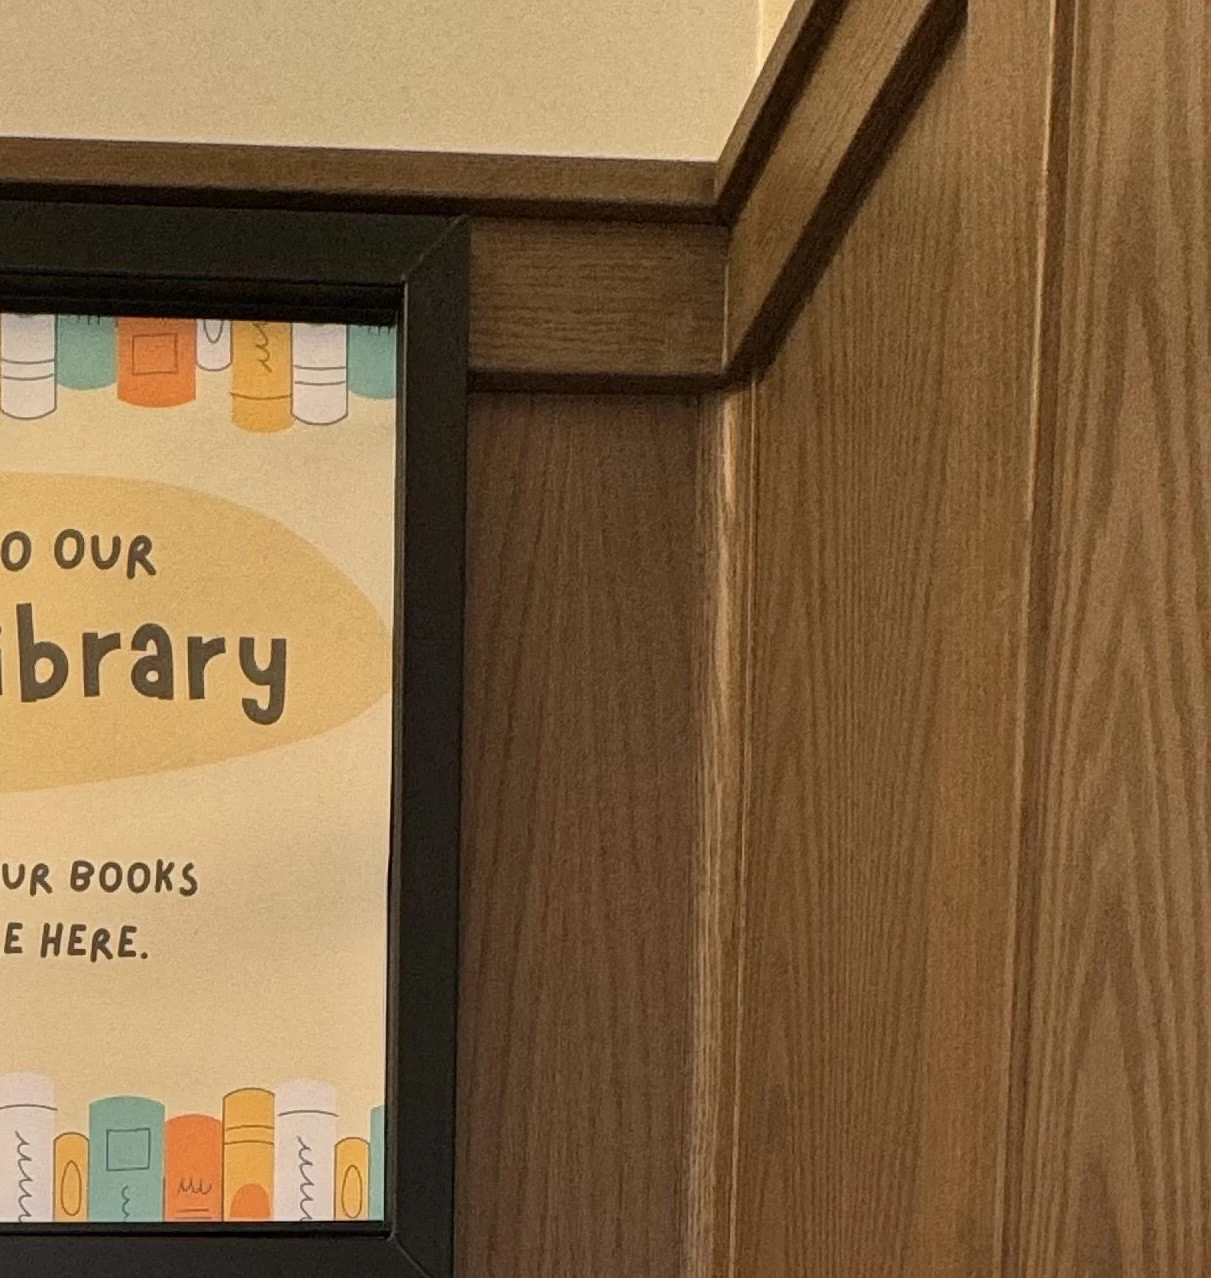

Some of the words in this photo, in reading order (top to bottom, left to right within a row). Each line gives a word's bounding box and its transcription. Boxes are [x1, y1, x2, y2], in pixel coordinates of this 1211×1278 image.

[54, 528, 155, 575] OUR
[70, 860, 198, 896] BOOKS
[39, 921, 148, 960] HERE.
